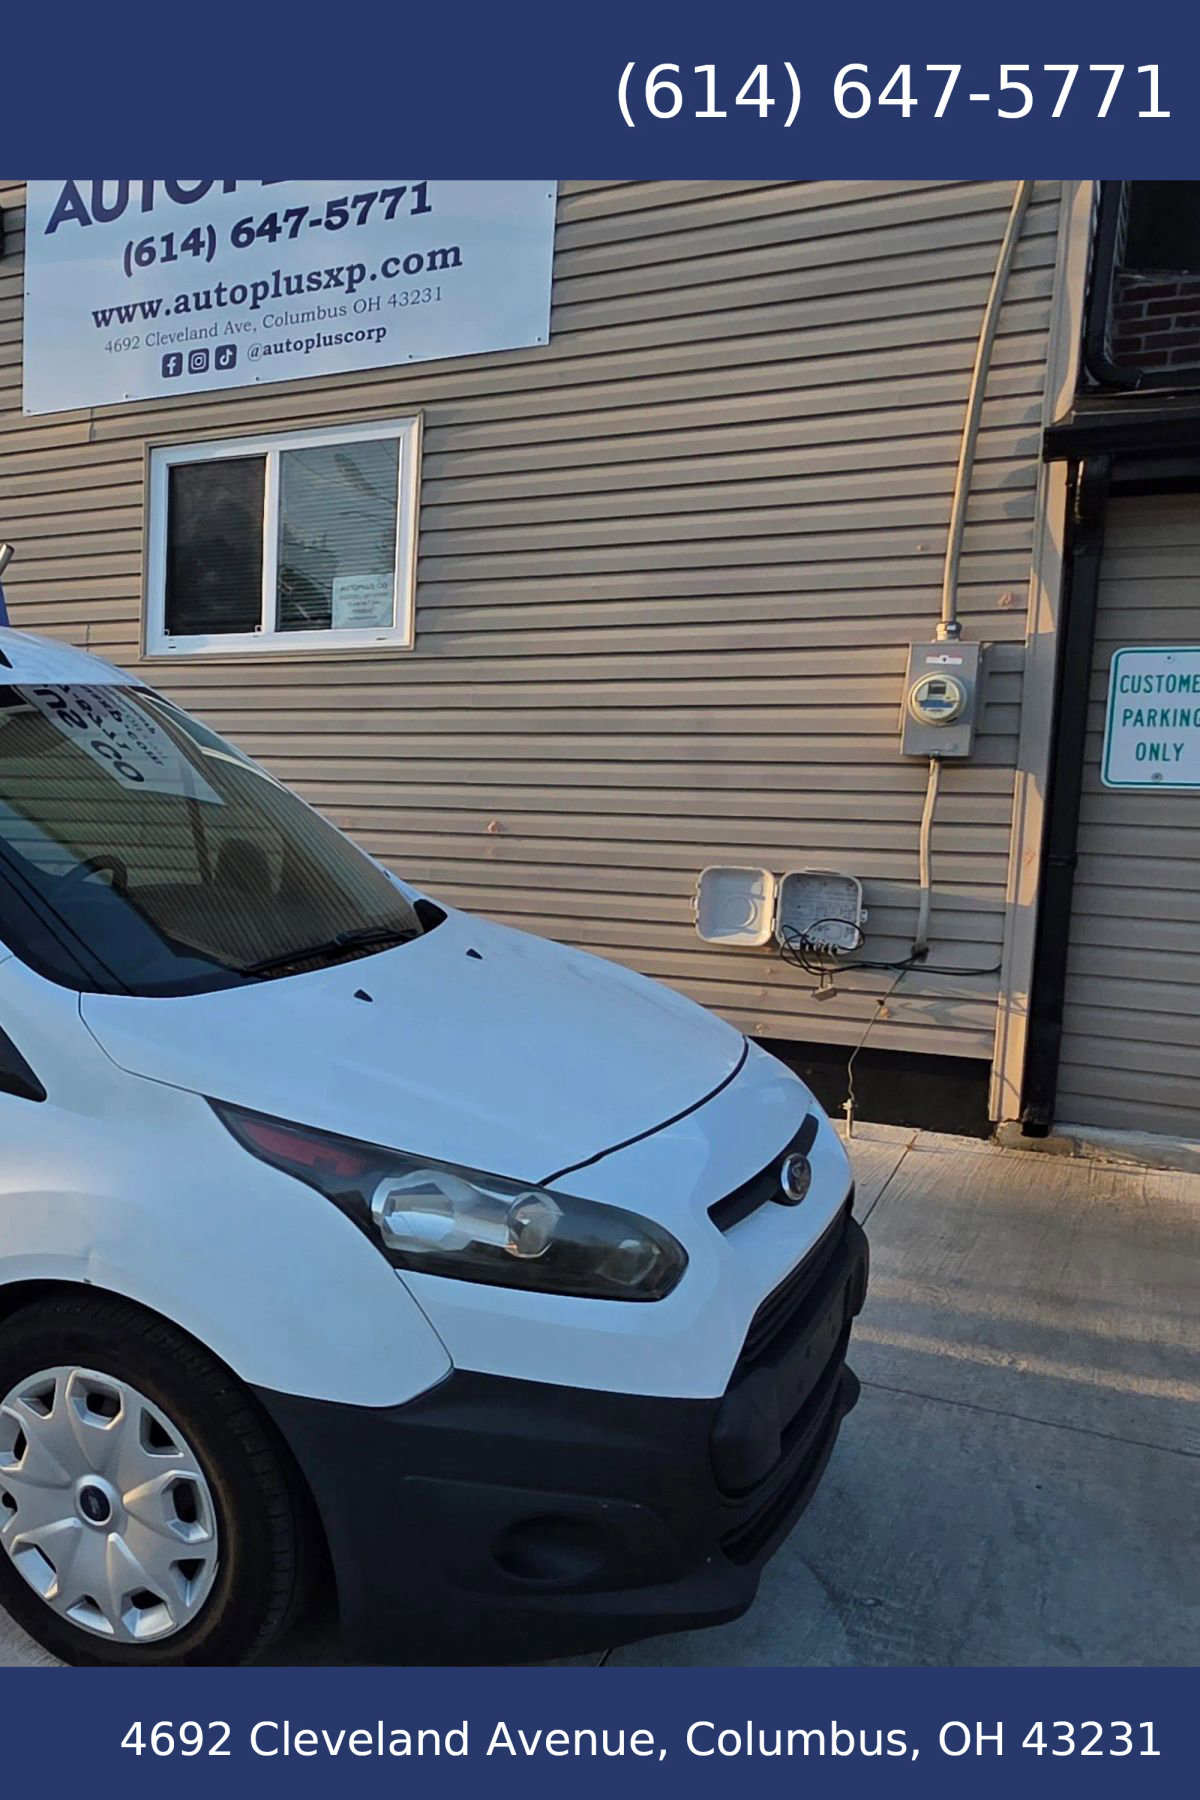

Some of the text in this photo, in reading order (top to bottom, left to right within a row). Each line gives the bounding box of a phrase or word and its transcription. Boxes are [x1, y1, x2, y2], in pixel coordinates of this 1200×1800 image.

[123, 182, 432, 277] (614) 647-5771
[91, 245, 462, 328] www.autoplusxp.com
[104, 287, 443, 354] 4692 Cleveland Ave, Columbus OH 43231
[247, 326, 388, 361] @autopluscorp
[1120, 674, 1200, 694] CUSTOME
[1135, 742, 1184, 762] ONLY
